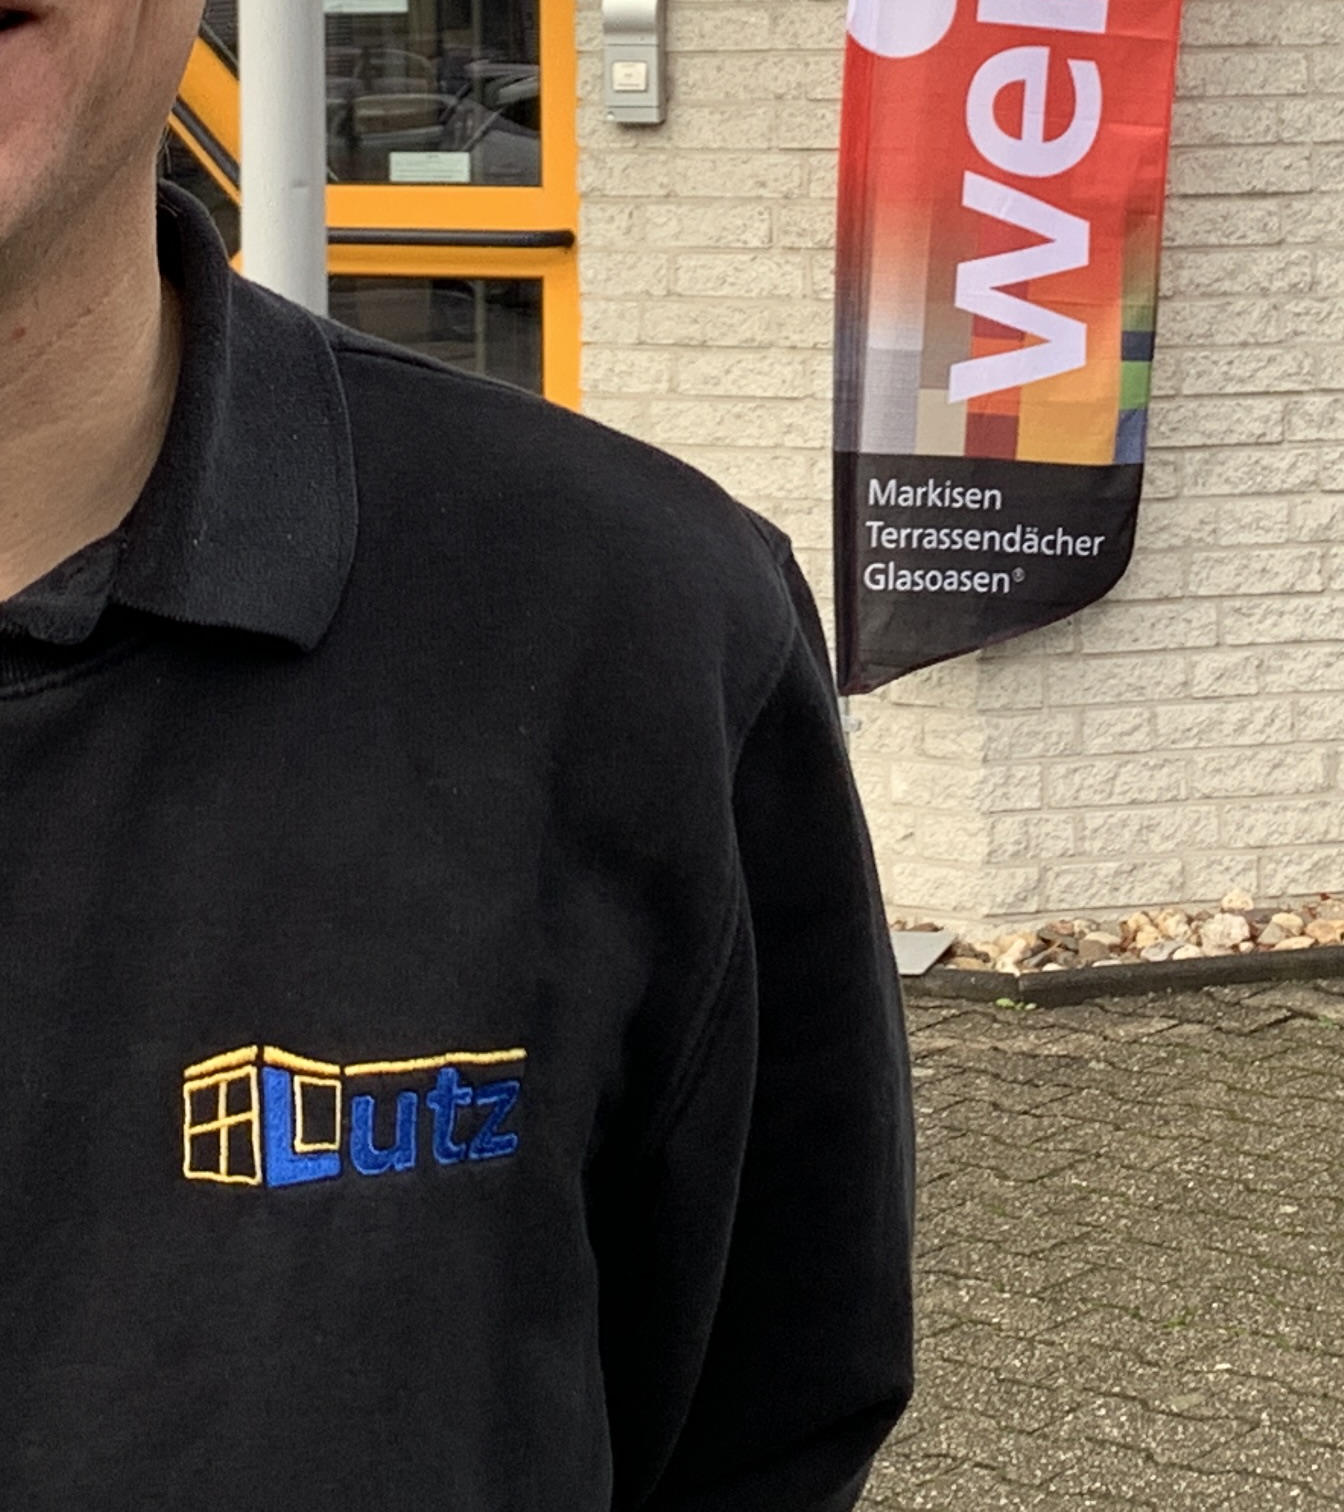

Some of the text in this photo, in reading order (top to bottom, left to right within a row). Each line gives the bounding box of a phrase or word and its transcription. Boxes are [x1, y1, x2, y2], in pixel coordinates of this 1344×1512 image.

[867, 478, 1003, 511] Markisen
[865, 520, 1106, 558] Terrassendächer
[262, 1065, 522, 1189] Lutz
